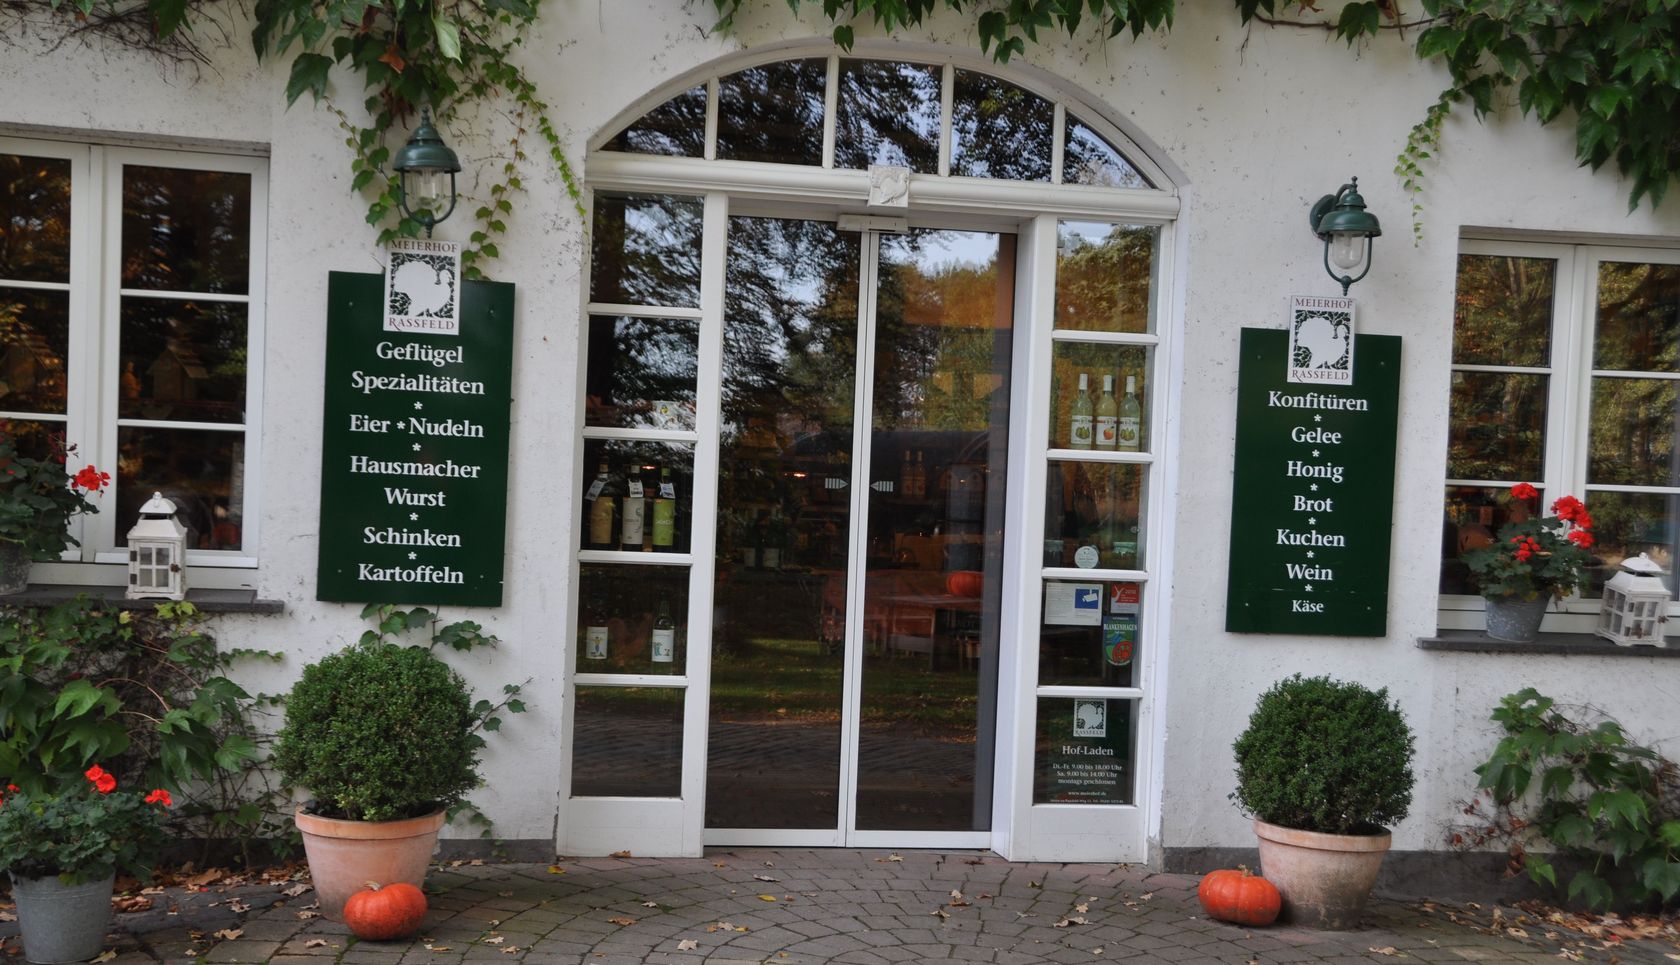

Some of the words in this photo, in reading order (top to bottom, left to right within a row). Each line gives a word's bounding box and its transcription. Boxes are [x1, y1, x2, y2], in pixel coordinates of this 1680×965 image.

[391, 240, 458, 252] MEIERHOF
[1295, 298, 1353, 309] MEIERHOF
[389, 317, 455, 331] RASSFELD
[376, 341, 463, 367] Geflügel
[352, 370, 485, 395] Spezialitäten
[1292, 369, 1349, 382] RASSFELD
[1268, 390, 1368, 411] Konfitüren
[349, 414, 391, 433] Eier
[408, 417, 484, 438] Nudeln
[1291, 426, 1342, 444] Gelee
[350, 455, 481, 478] Hausmacher
[1286, 460, 1344, 483] Honig
[384, 487, 446, 507] Wurst
[1293, 495, 1333, 512] Brot
[363, 526, 461, 547] Schinken
[1276, 529, 1345, 547] Kuchen
[358, 563, 464, 584] Kartoffeln
[1286, 563, 1333, 580] Wein
[1292, 599, 1324, 612] Käse
[1062, 745, 1114, 756] Hof-Laden
